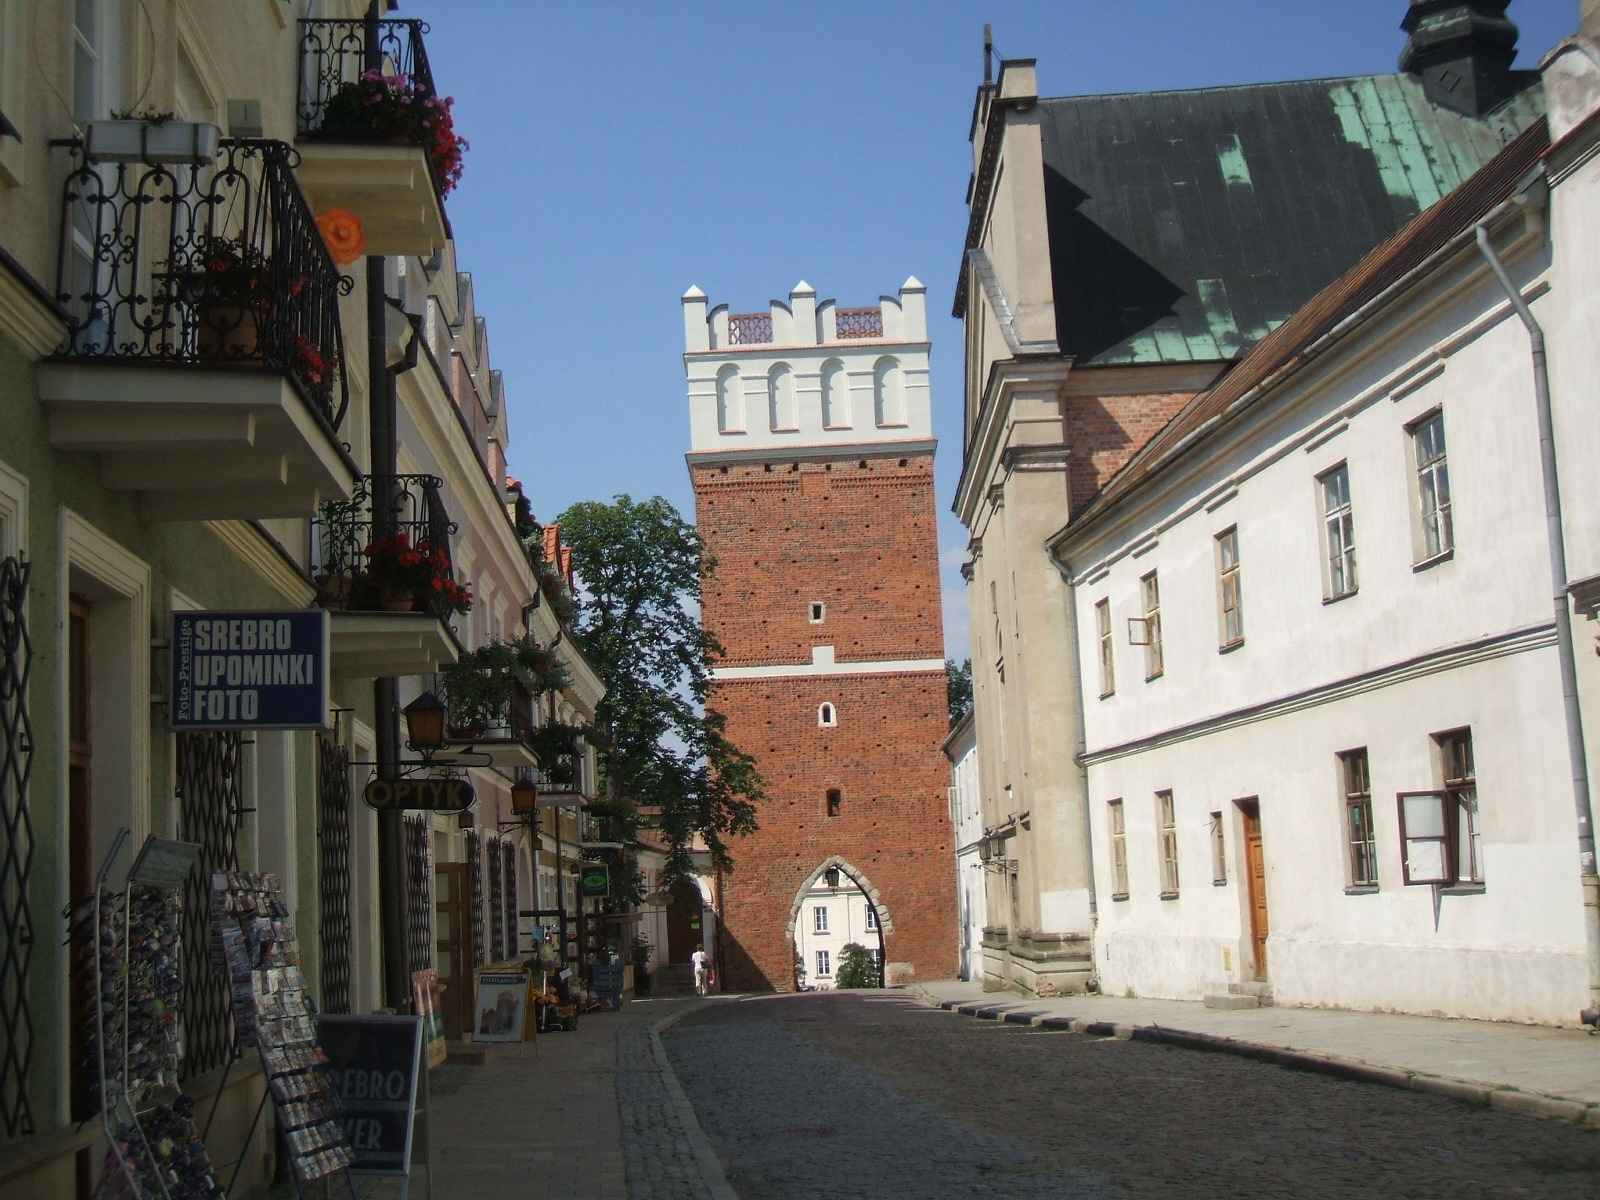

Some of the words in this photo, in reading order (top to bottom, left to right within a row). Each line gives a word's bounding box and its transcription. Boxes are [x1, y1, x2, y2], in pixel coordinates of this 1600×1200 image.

[194, 619, 292, 650] SREBRO
[194, 654, 314, 686] UPOMINKI
[194, 689, 259, 721] FOTO
[367, 782, 464, 808] OPTYK
[340, 1069, 404, 1101] EBRO
